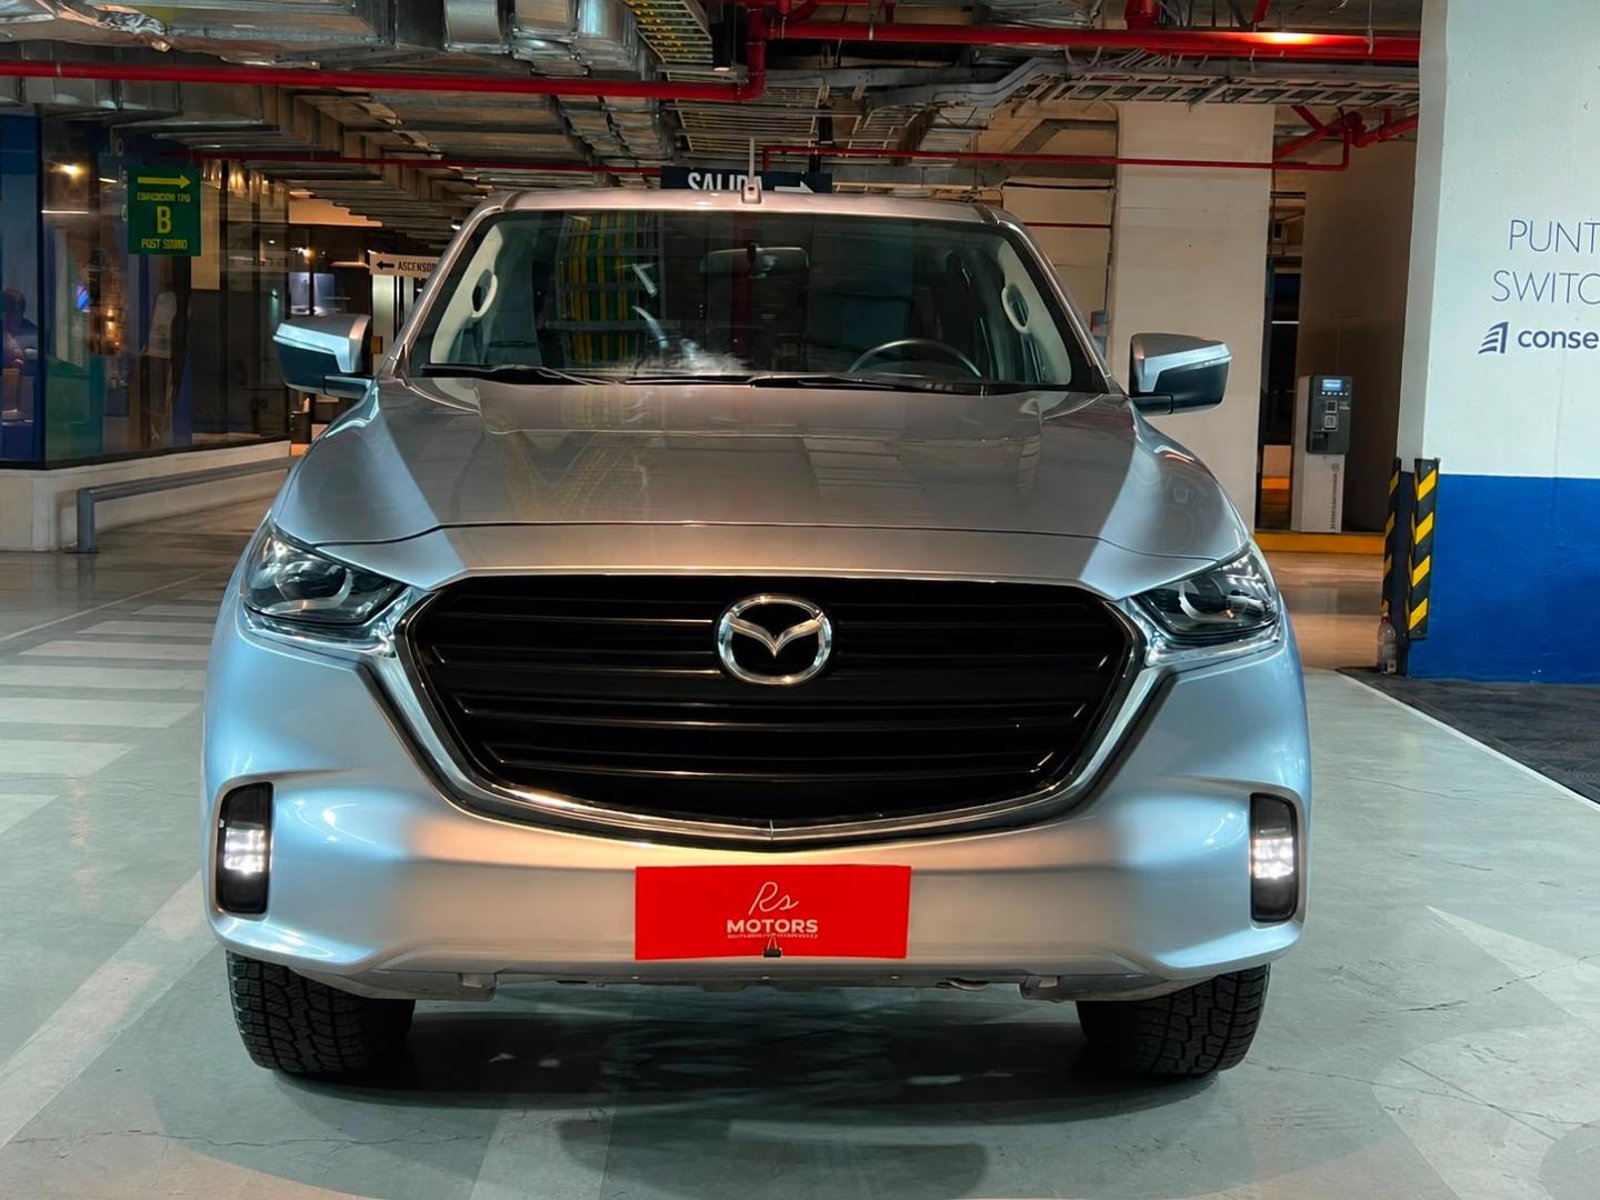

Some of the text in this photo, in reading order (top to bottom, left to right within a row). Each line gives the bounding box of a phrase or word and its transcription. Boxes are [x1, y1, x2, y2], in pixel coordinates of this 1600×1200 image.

[157, 205, 172, 234] B
[141, 238, 161, 249] POST
[1509, 219, 1600, 254] PUNT
[1517, 330, 1600, 349] conse
[748, 881, 799, 916] Rs
[727, 919, 818, 933] MOTORS
